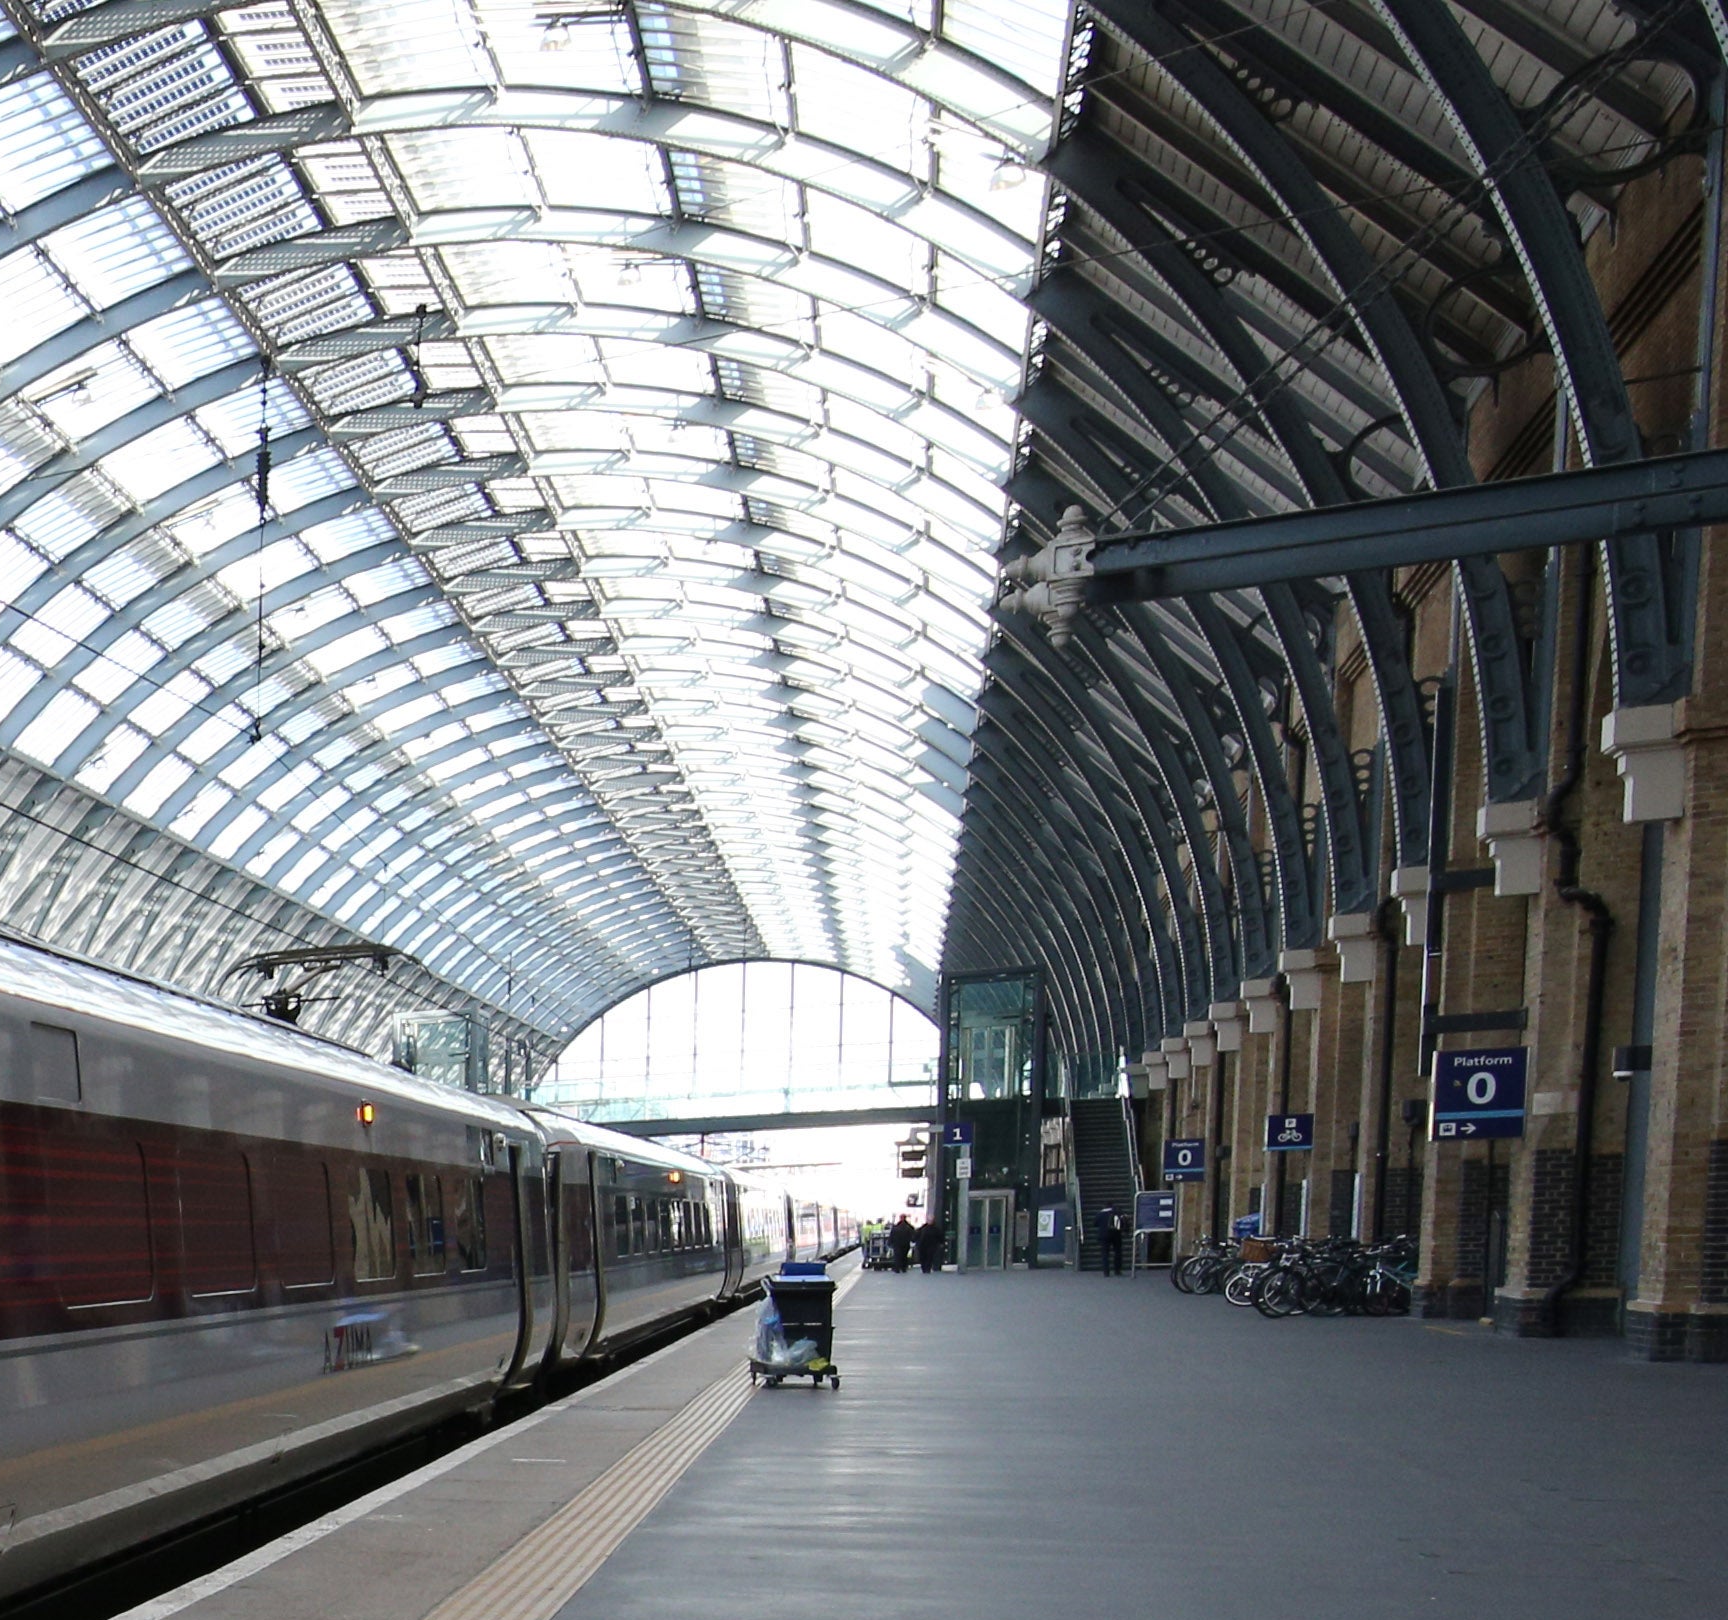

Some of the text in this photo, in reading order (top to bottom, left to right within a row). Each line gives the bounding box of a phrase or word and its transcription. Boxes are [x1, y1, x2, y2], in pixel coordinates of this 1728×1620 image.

[1453, 1055, 1513, 1067] Platform
[1467, 1071, 1497, 1105] 0
[952, 1128, 963, 1141] 1
[1178, 1149, 1192, 1166] 0
